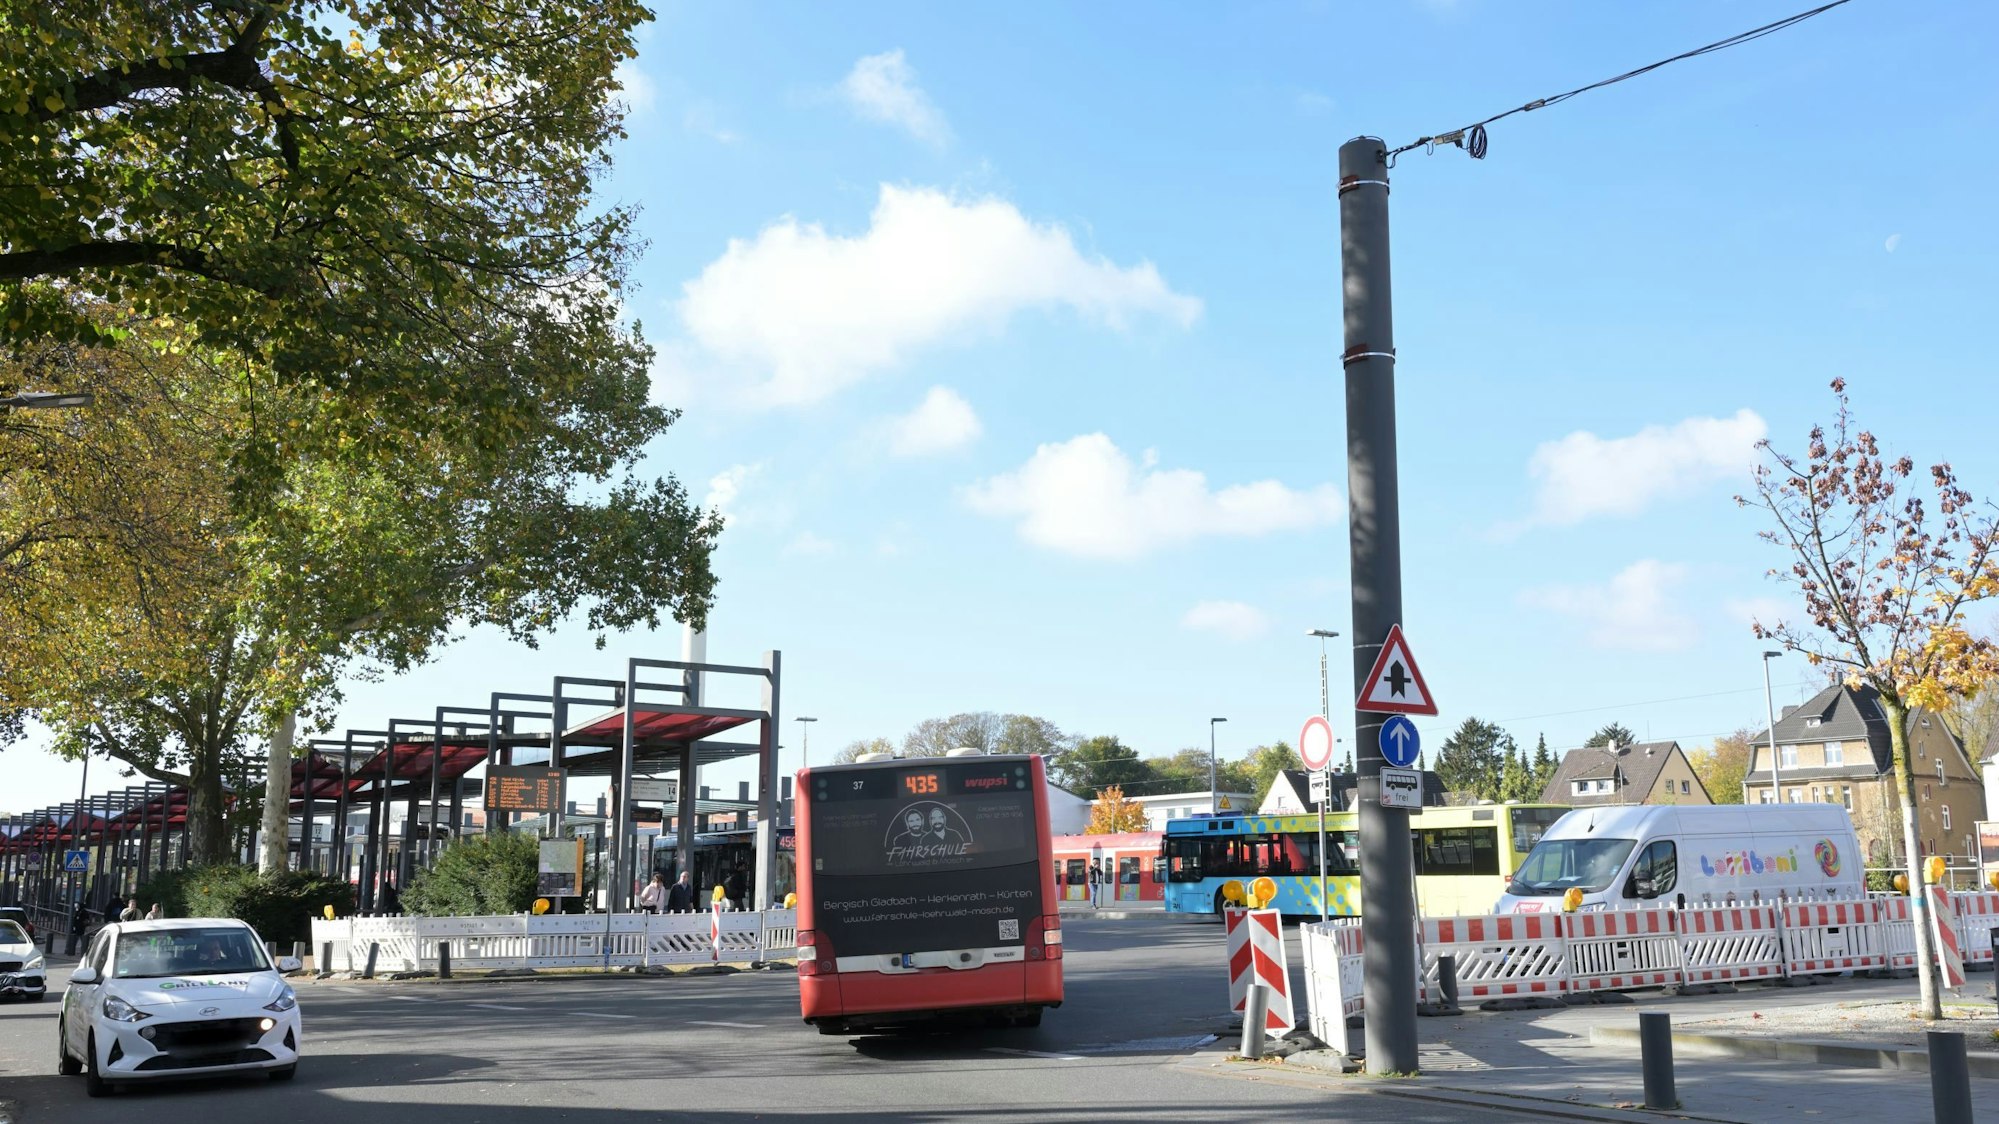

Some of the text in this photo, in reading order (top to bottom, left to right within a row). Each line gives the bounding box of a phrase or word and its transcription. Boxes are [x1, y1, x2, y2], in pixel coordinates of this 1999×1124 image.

[852, 781, 864, 790] 37
[905, 775, 938, 794] 435
[964, 773, 1008, 789] wupsi
[668, 787, 676, 795] 14
[1395, 792, 1409, 802] frei
[886, 842, 970, 862] FAHRSCHULE
[1144, 856, 1149, 865] 2
[823, 899, 869, 912] Bergisch
[870, 895, 917, 908] Gladbach
[927, 891, 987, 905] Herkenrath
[997, 888, 1033, 899] Kürten
